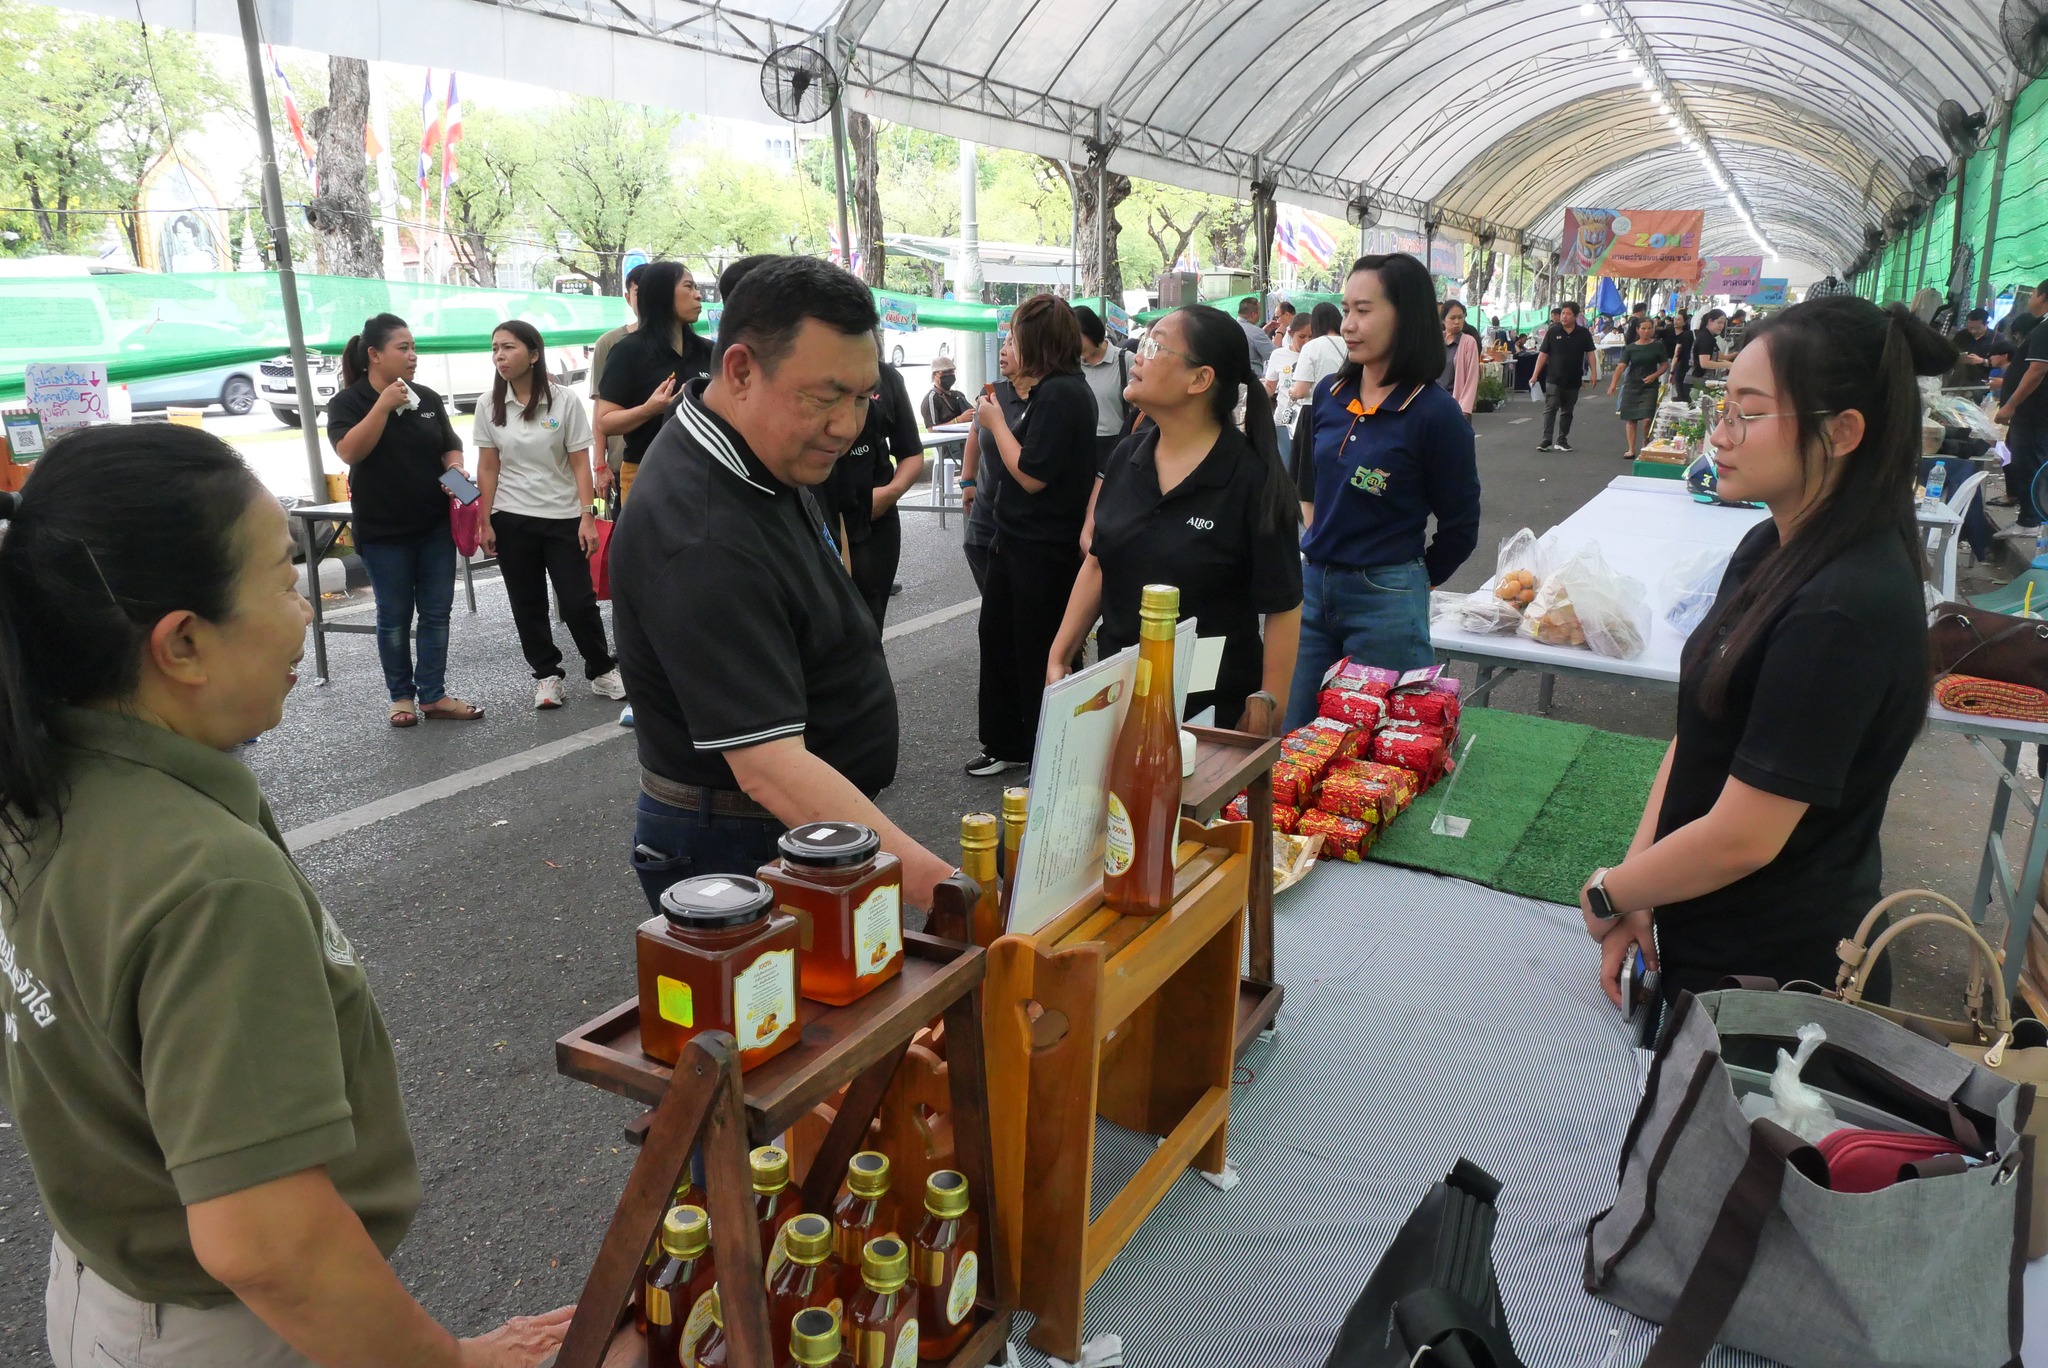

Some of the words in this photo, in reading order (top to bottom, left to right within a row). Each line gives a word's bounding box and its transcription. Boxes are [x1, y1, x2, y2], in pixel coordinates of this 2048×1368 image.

[1634, 232, 1695, 249] ZONE
[79, 391, 101, 414] 50
[1186, 516, 1214, 530] ALRO
[1112, 824, 1132, 836] 100%
